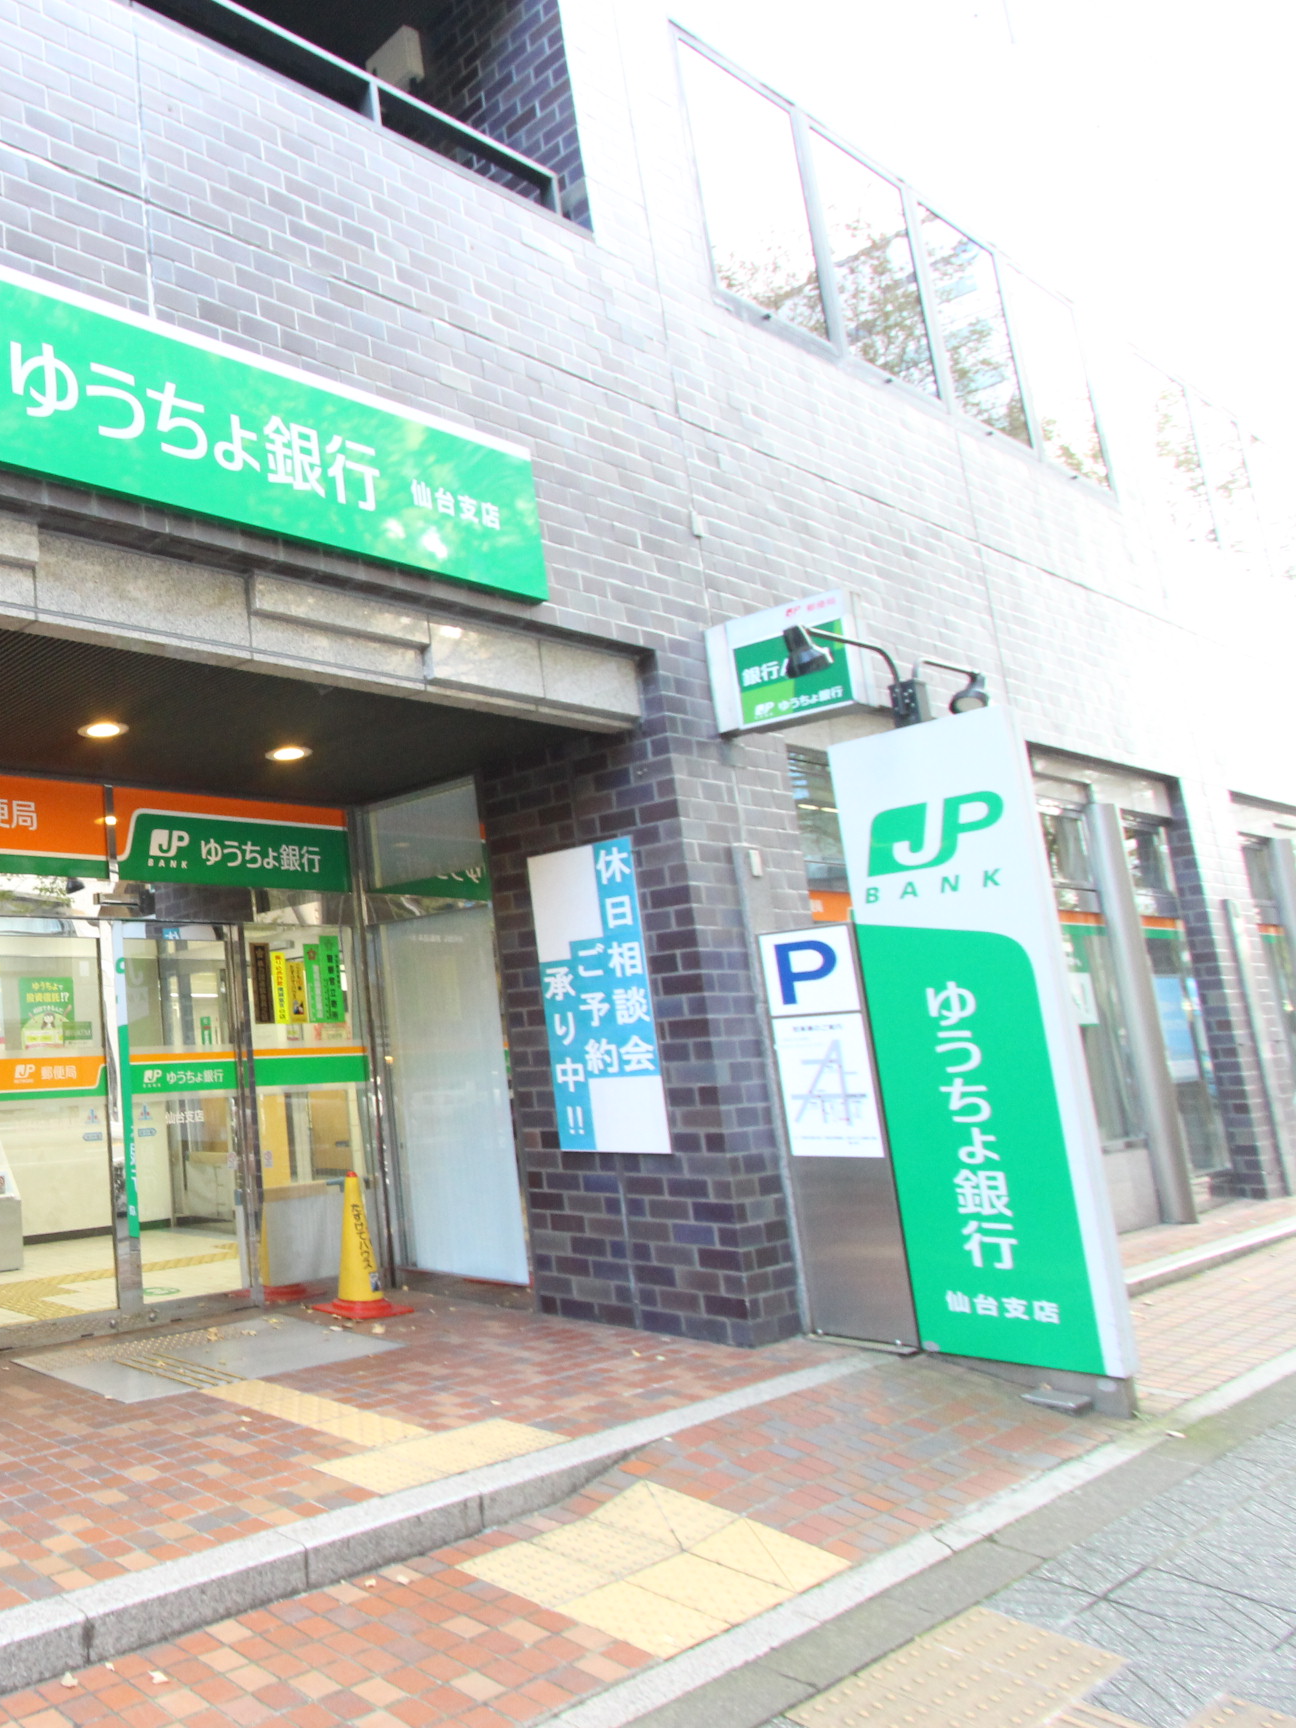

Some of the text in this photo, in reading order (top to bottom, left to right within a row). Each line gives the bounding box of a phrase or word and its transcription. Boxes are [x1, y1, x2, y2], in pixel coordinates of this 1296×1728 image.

[8, 339, 502, 531] ゆうちょ銀行 仙台支店
[777, 685, 844, 712] ゆうちょ銀行
[148, 828, 321, 873] JP ゆうちょ銀行
[867, 790, 1004, 878] JP
[147, 858, 189, 869] BANK
[864, 867, 1002, 905] BANK
[596, 846, 655, 1072] 休日相談会
[773, 939, 838, 1006] P
[577, 943, 620, 1075] ご予約
[40, 1065, 77, 1081] 郵便局
[166, 1069, 224, 1085] ゆうちょ銀行
[925, 980, 1019, 1271] ゆうちょ銀行
[945, 1289, 1061, 1324] 仙台支店
